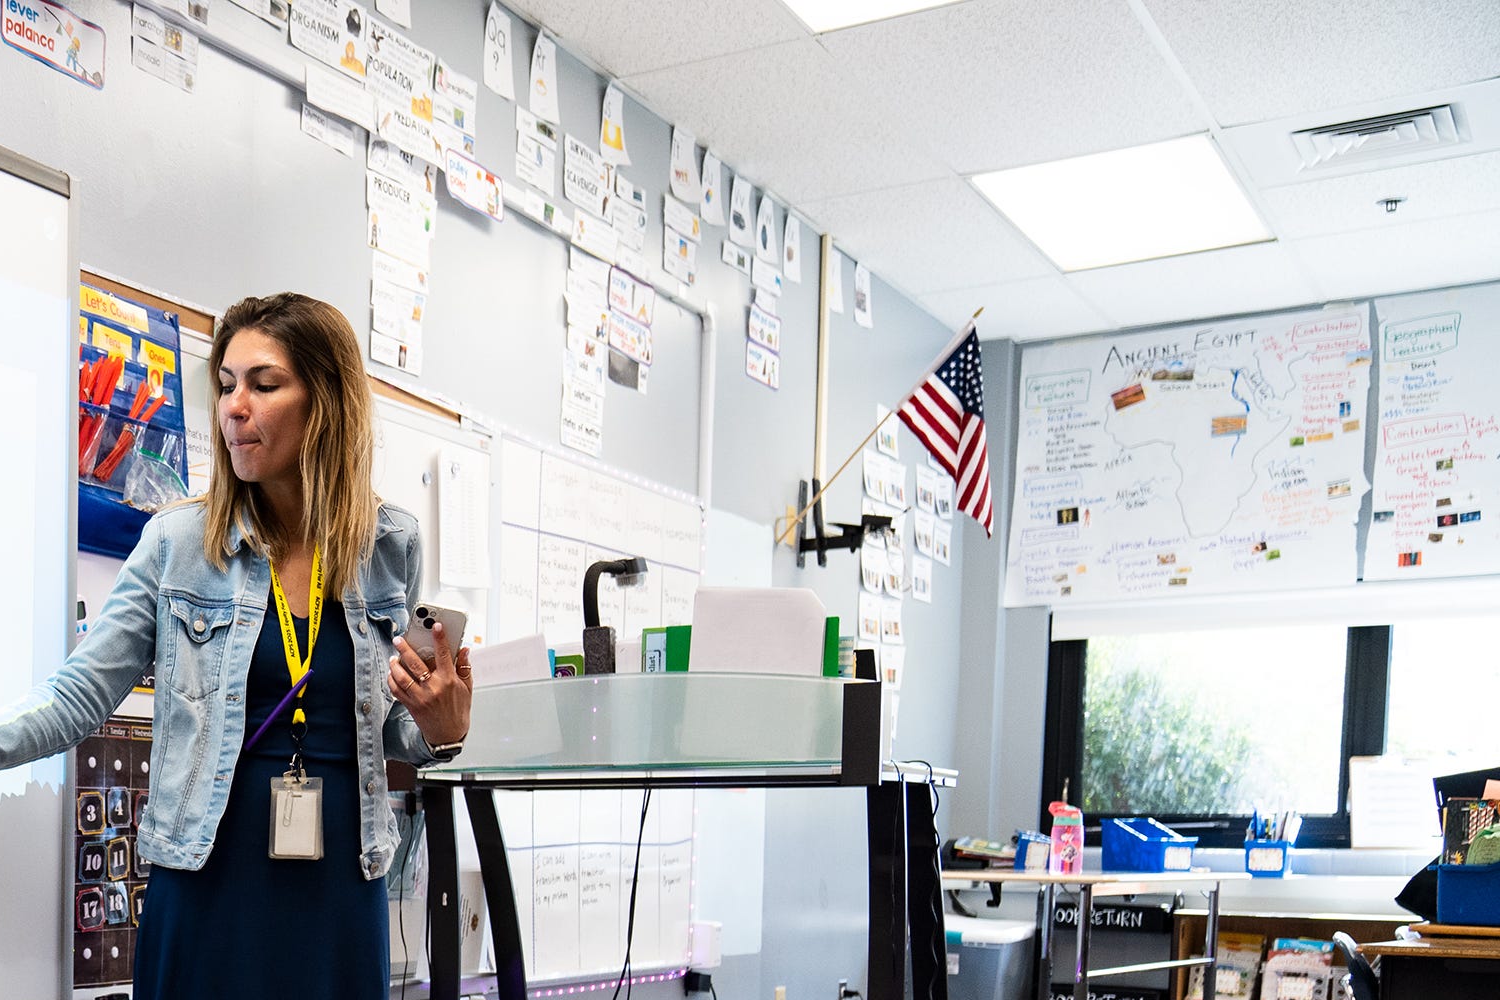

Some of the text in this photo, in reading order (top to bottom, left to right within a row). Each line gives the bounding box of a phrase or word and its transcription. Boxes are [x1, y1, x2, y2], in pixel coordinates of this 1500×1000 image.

[5, 17, 55, 51] palanca
[291, 8, 340, 43] ORGANISM
[367, 53, 414, 93] POPULATION
[395, 111, 431, 137] PREDATOR
[570, 140, 594, 164] SURVIVAL
[373, 176, 410, 203] PRODUCER
[567, 169, 598, 196] SCAVENGER
[86, 293, 136, 323] Let's Count
[105, 334, 121, 350] Tens
[1193, 329, 1258, 353] EGYPT
[149, 349, 167, 364] Ones
[1102, 345, 1180, 375] ANCIENT
[585, 426, 600, 439] matter
[1387, 422, 1459, 440] Contributions
[1104, 455, 1133, 472] AFRICA
[1385, 447, 1444, 465] Architecture
[1268, 467, 1305, 479] Indian
[1115, 487, 1151, 500] Atlantic
[87, 799, 123, 821] 3 4
[85, 849, 124, 871] 10 11
[83, 893, 123, 918] 17 18
